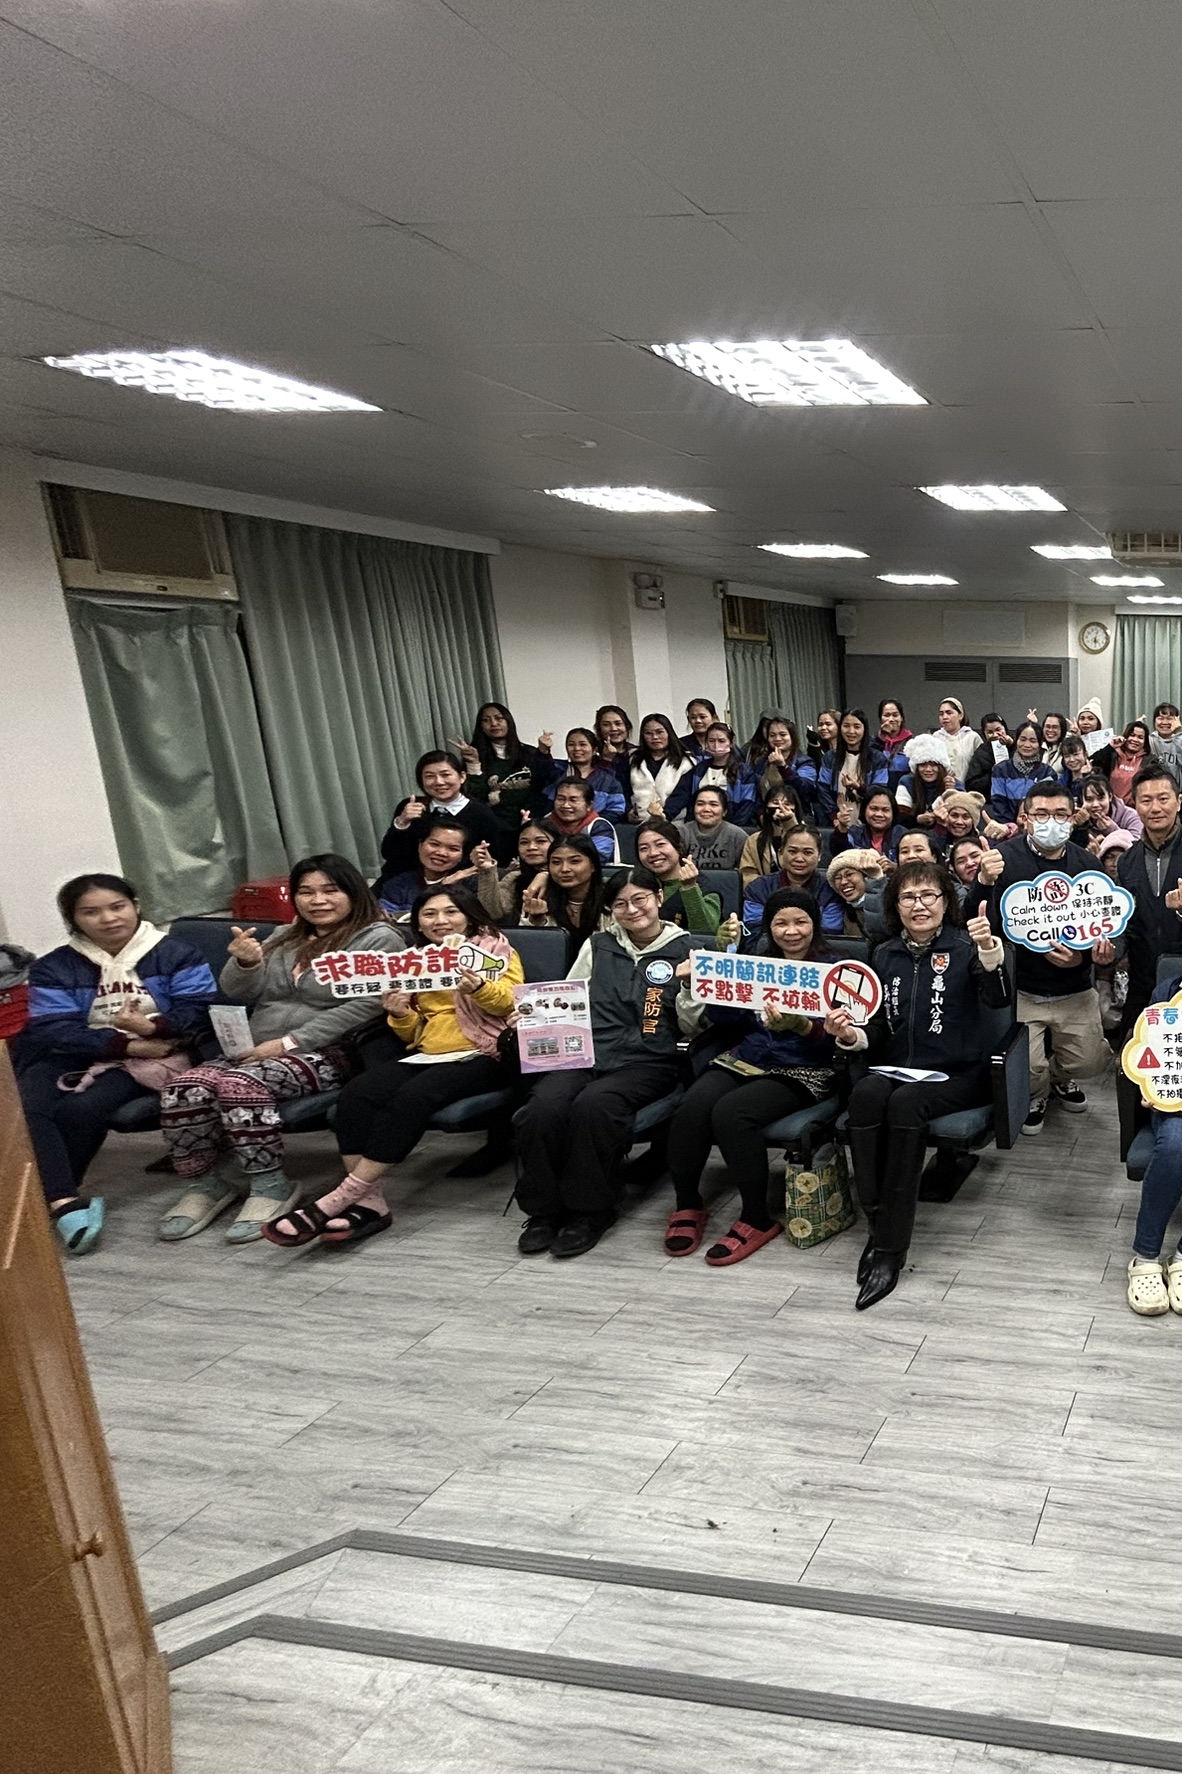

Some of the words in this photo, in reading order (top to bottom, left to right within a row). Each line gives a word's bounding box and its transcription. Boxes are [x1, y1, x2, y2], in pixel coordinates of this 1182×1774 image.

[1075, 882, 1095, 896] 3C
[1007, 916, 1040, 927] Check
[1044, 914, 1054, 924] it
[1056, 912, 1076, 922] out
[1080, 906, 1121, 919] 小心查證
[1011, 906, 1036, 916] Calm
[1040, 901, 1068, 913] down
[1072, 895, 1114, 908] 保持冷靜
[1027, 928, 1060, 942] Call
[1077, 918, 1114, 941] 165
[315, 946, 459, 982] 求職防詐
[695, 955, 820, 989] 不明簡訊連結
[334, 981, 382, 995] 要存疑
[388, 978, 433, 991] 要查證
[695, 978, 754, 1004] 不點擊
[762, 987, 821, 1012] 不填輸
[642, 987, 664, 1034] 家防官
